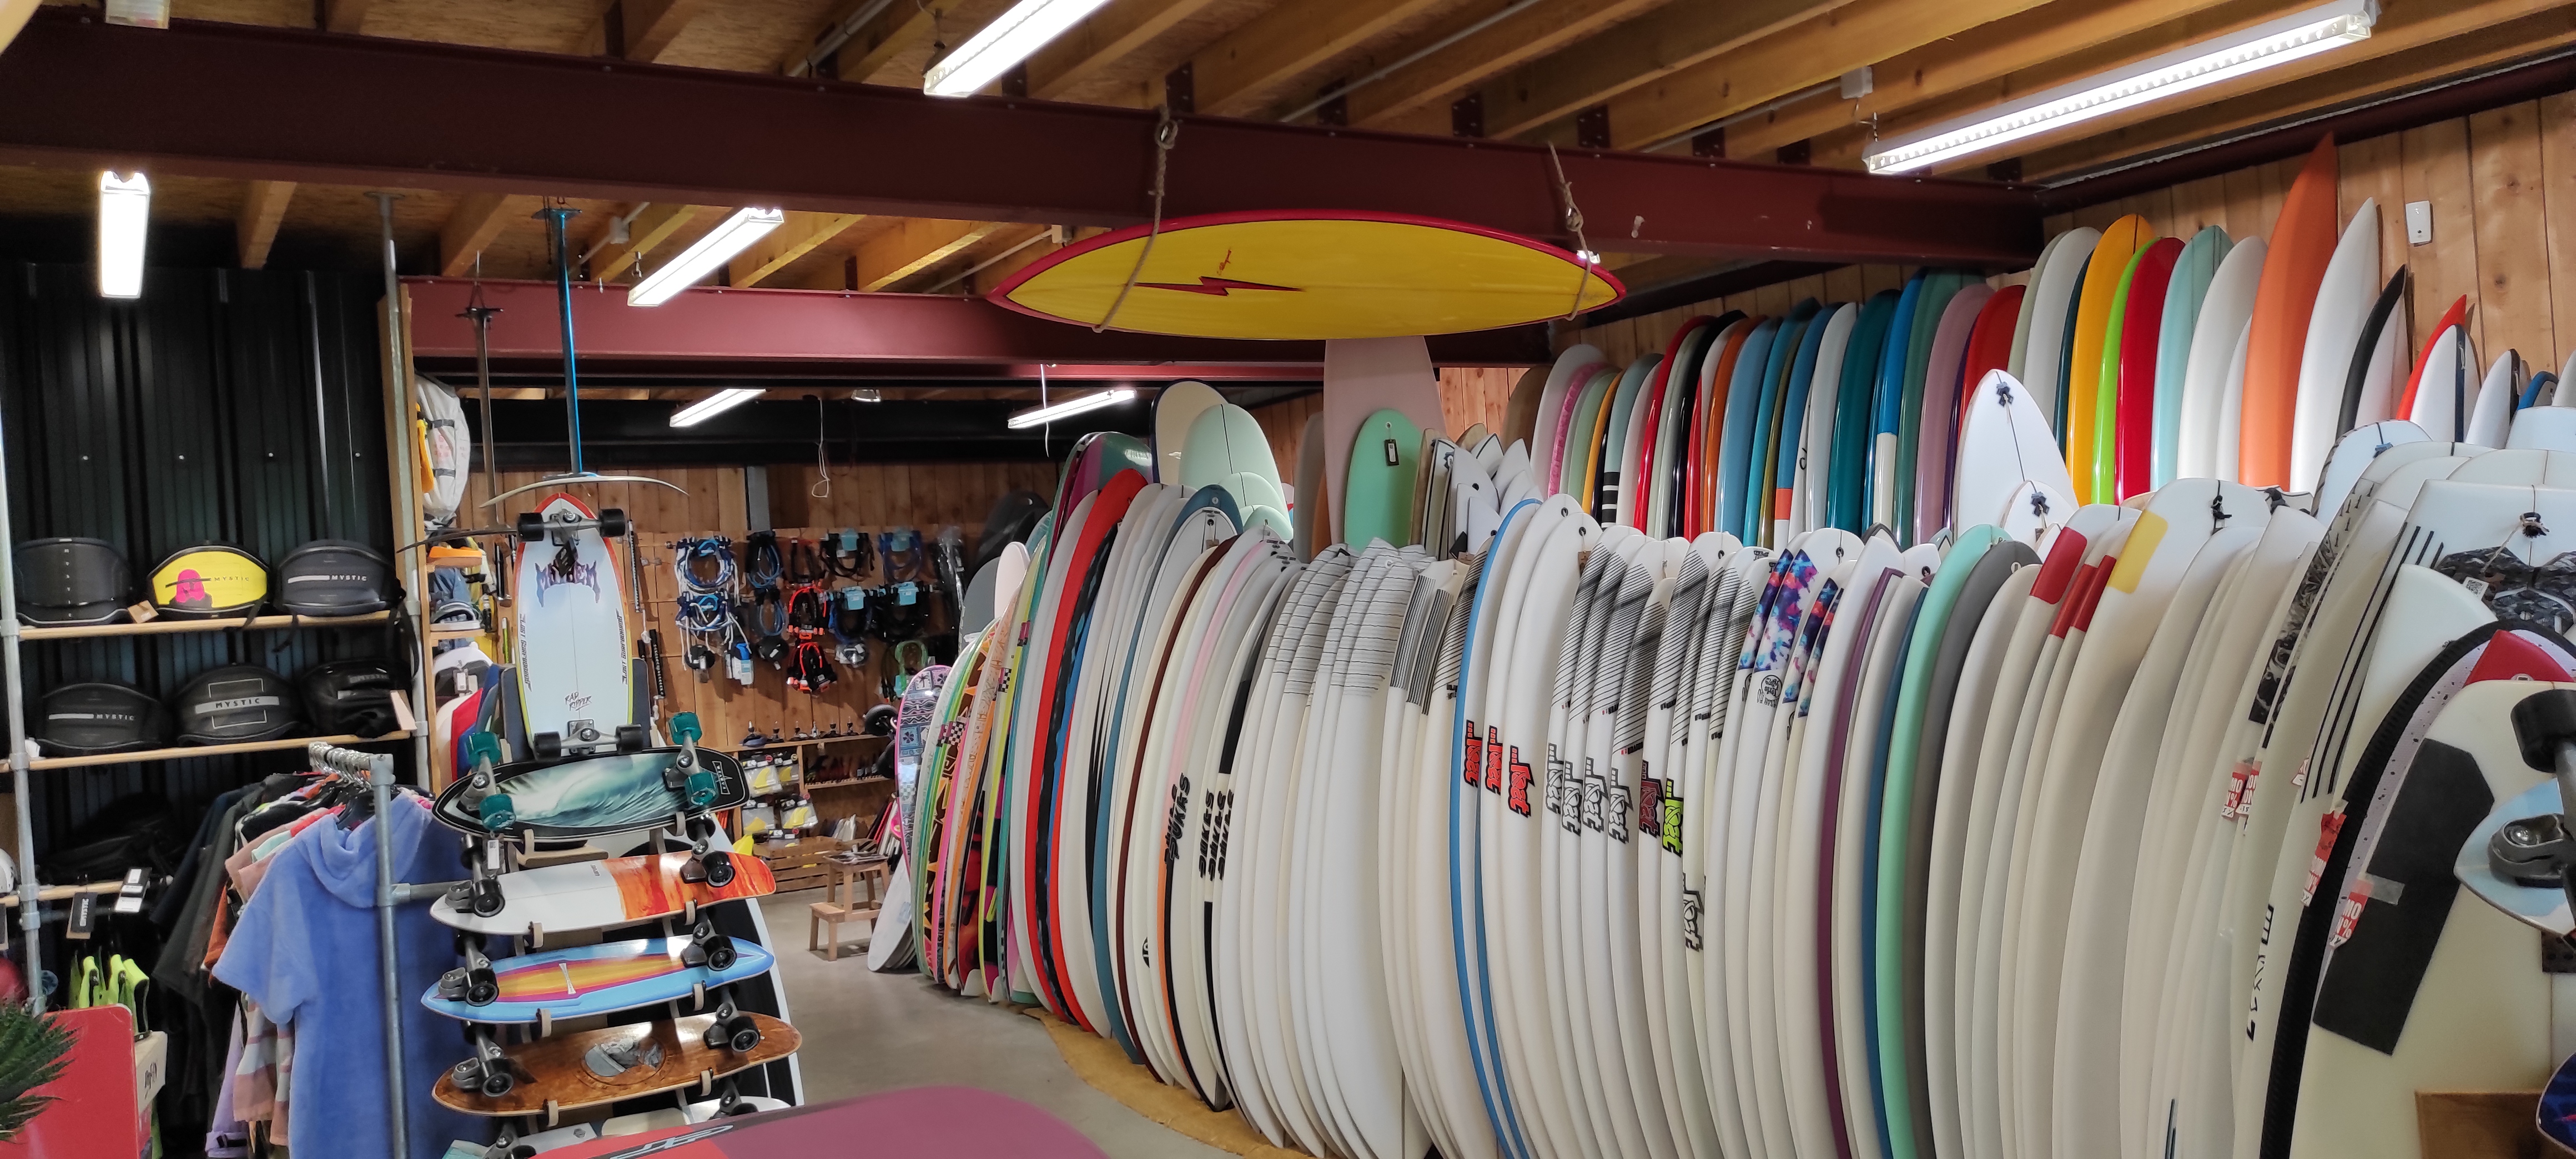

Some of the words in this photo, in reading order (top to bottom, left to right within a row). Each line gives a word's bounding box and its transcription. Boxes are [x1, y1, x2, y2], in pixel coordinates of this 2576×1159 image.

[215, 698, 260, 708] MYSTIC
[565, 691, 579, 705] RAD
[1169, 772, 1190, 860] PUKAS
